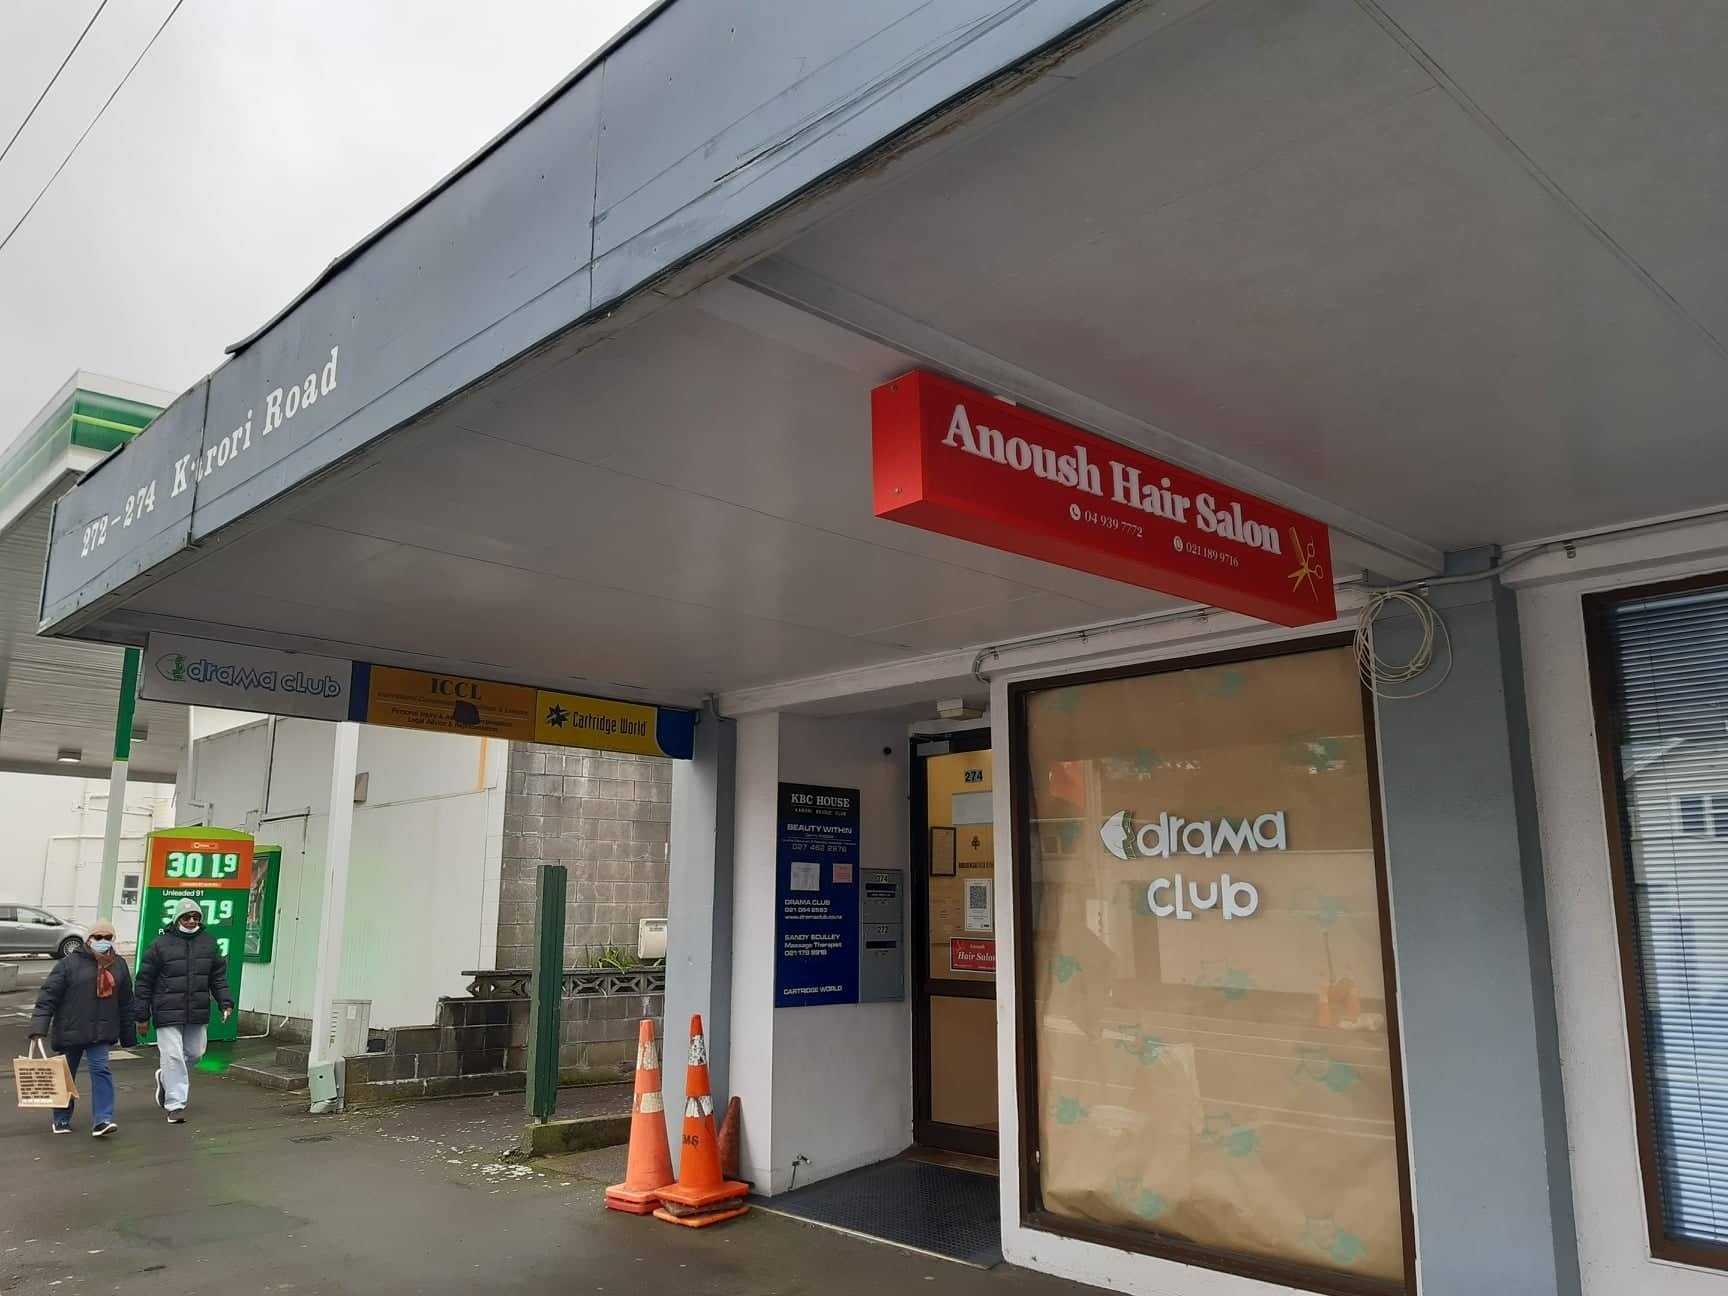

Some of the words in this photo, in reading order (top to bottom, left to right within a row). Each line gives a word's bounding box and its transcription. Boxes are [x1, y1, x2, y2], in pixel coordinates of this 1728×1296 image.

[261, 345, 340, 436] Road
[941, 403, 1104, 497] Anoush
[1108, 460, 1191, 526] Hair
[1196, 492, 1283, 555] Salon
[1083, 510, 1098, 526] 04
[1100, 514, 1119, 532] 939
[1120, 520, 1144, 539] 7772
[1185, 541, 1201, 557] 021
[1203, 546, 1218, 561] 189
[1219, 551, 1240, 568] 9716
[431, 677, 482, 701] ICCL
[572, 711, 616, 735] Cartridge
[620, 717, 646, 737] World
[965, 769, 983, 783] 274
[791, 793, 813, 805] KBC
[816, 796, 850, 808] HOUSE
[786, 823, 821, 833] BEAUTY
[822, 826, 852, 834] WITHIN
[814, 941, 842, 949] Therapist
[957, 950, 975, 961] Hair
[783, 986, 819, 995] CARTRIDGE
[820, 985, 842, 993] WORLD
